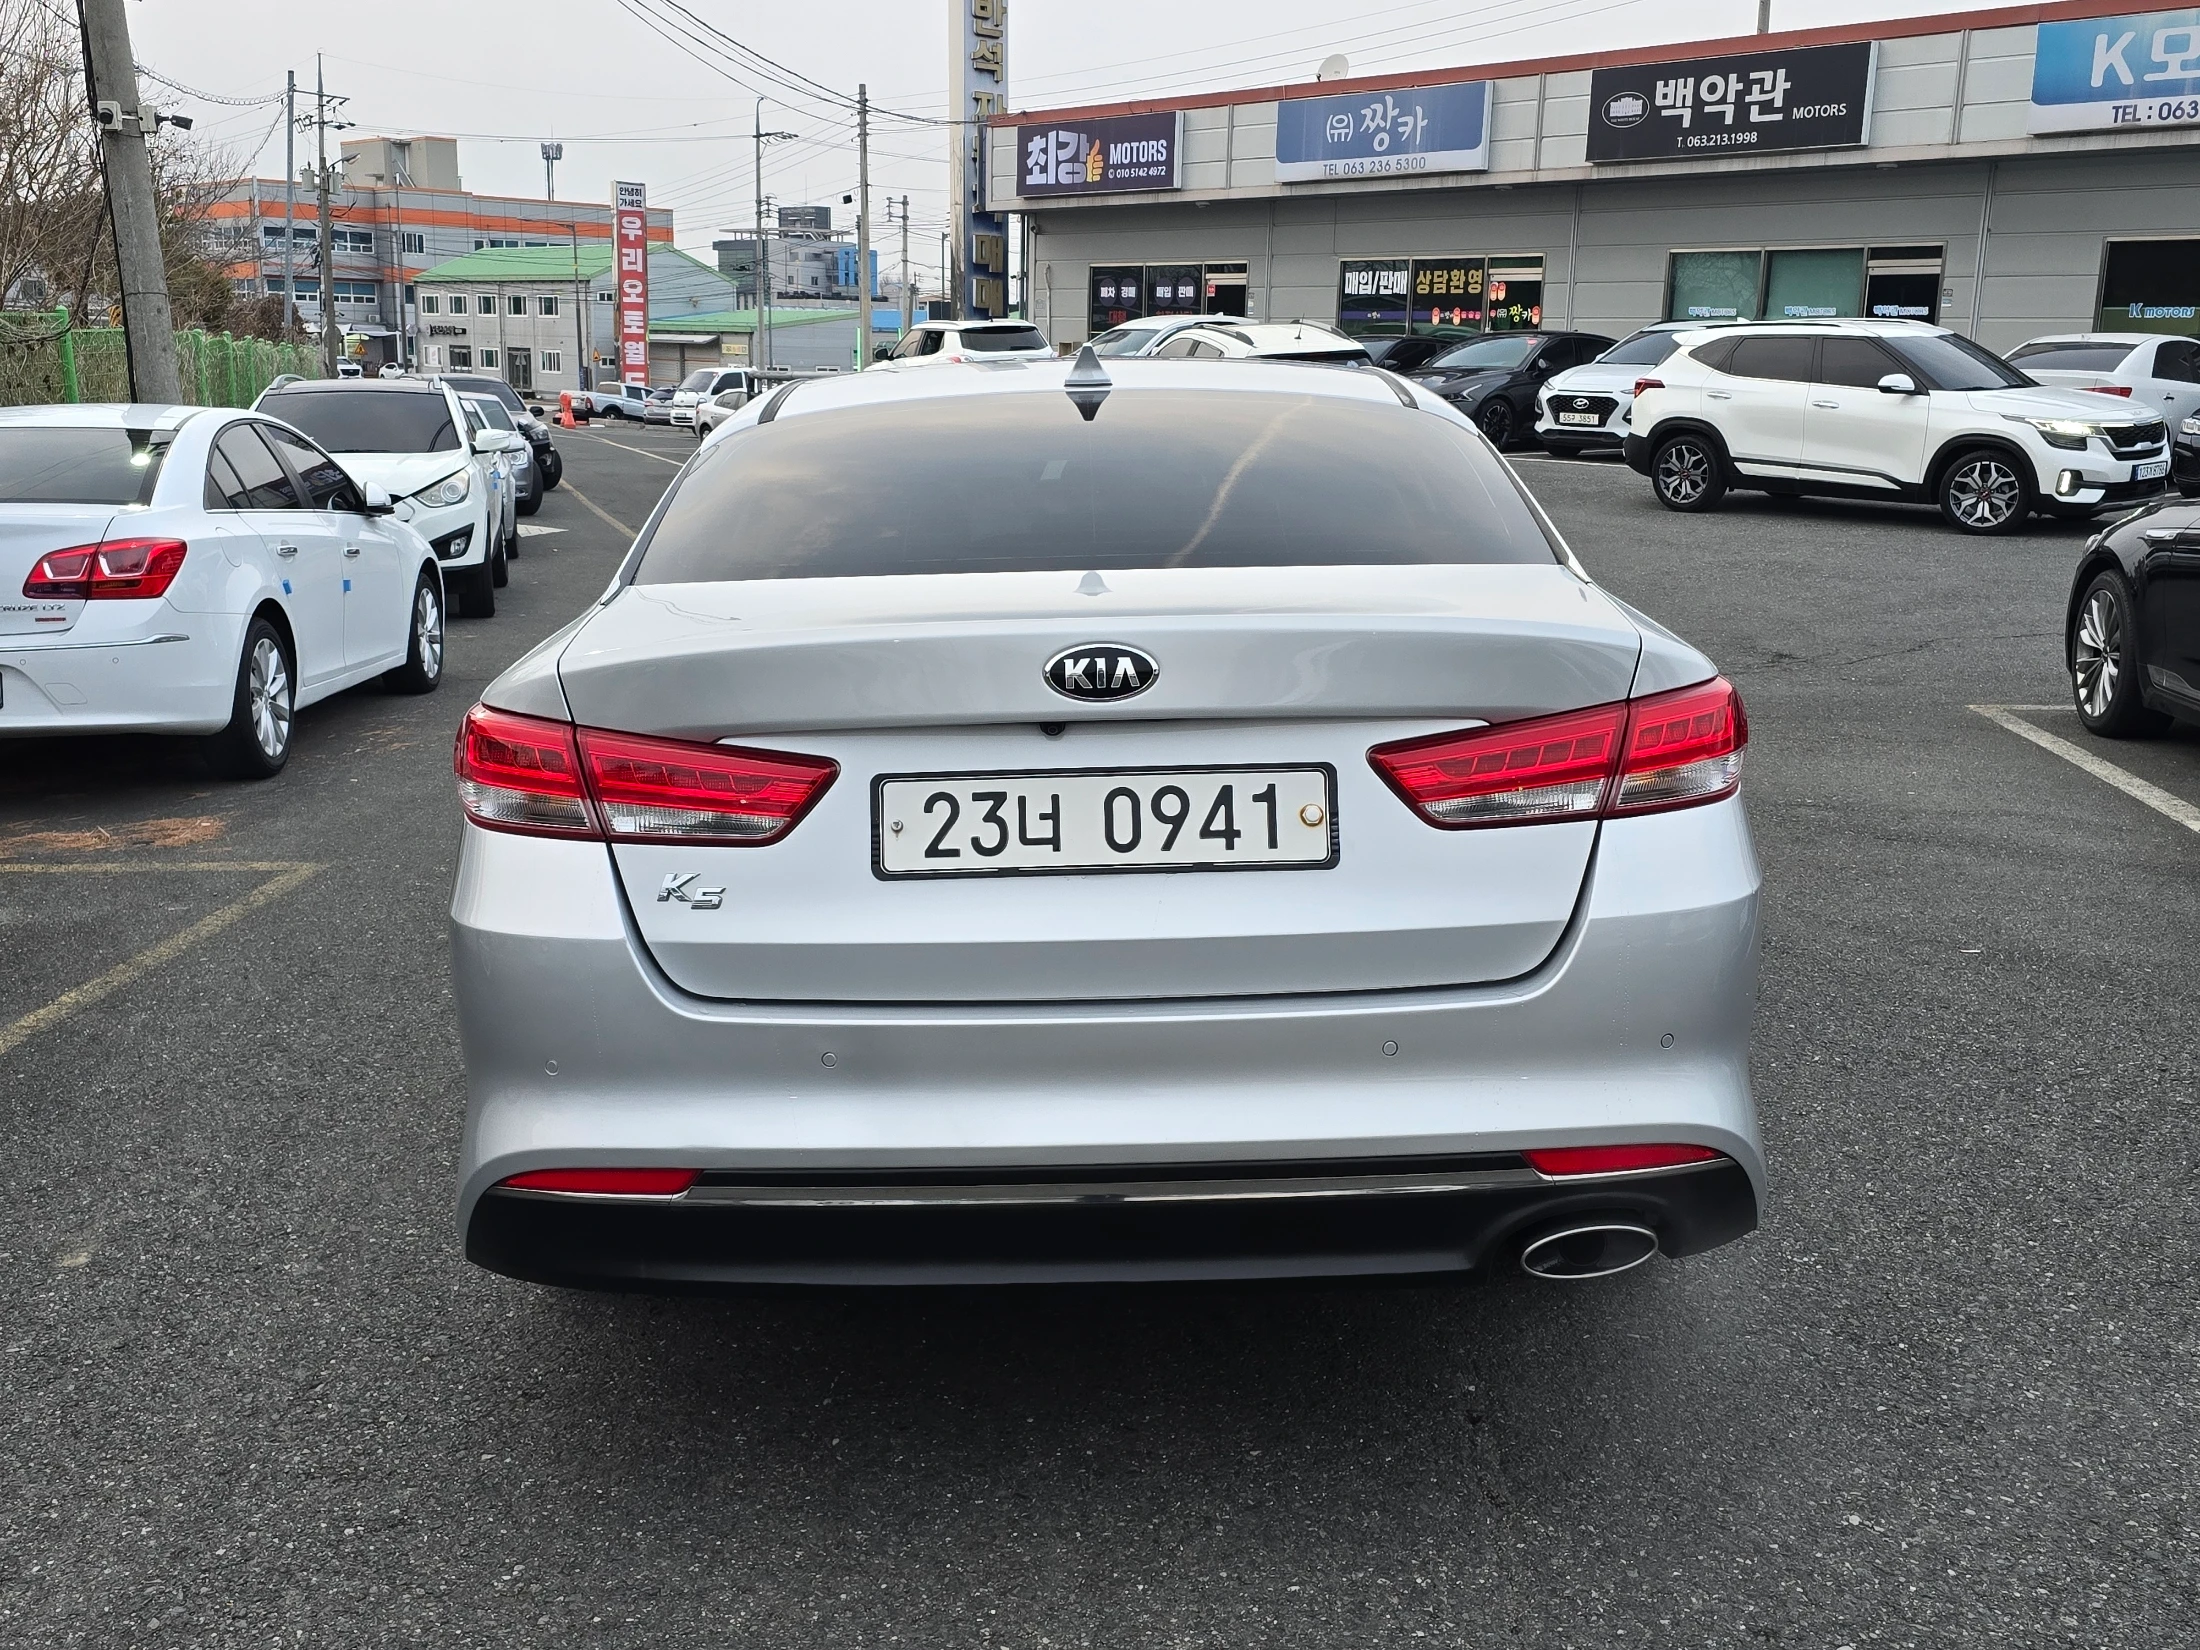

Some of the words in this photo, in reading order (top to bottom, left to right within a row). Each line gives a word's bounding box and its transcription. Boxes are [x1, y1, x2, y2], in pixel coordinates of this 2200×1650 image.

[2091, 32, 2136, 87] K
[1655, 69, 1791, 128] 백악관
[1792, 103, 1847, 119] MOTORS
[2158, 100, 2199, 120] 063
[1360, 95, 1428, 151] 짱카
[1687, 132, 1758, 148] 063.213.1998
[1026, 130, 1089, 184] 최강
[1110, 140, 1167, 164] MOTORS
[1323, 163, 1339, 176] TEL
[1343, 162, 1364, 175] 063
[1370, 160, 1390, 173] 236
[1396, 157, 1426, 170] 5300
[1116, 168, 1129, 178] 010
[619, 187, 642, 197] 안녕히
[620, 198, 642, 208] 가세요
[1344, 271, 1407, 294] 매입/판매
[1416, 270, 1483, 294] 상담환영
[2129, 303, 2143, 318] K
[1578, 415, 1595, 423] 3851
[1062, 657, 1141, 689] KIA
[922, 790, 1062, 859] 23너
[1104, 783, 1280, 854] 0941
[656, 872, 727, 909] K5
